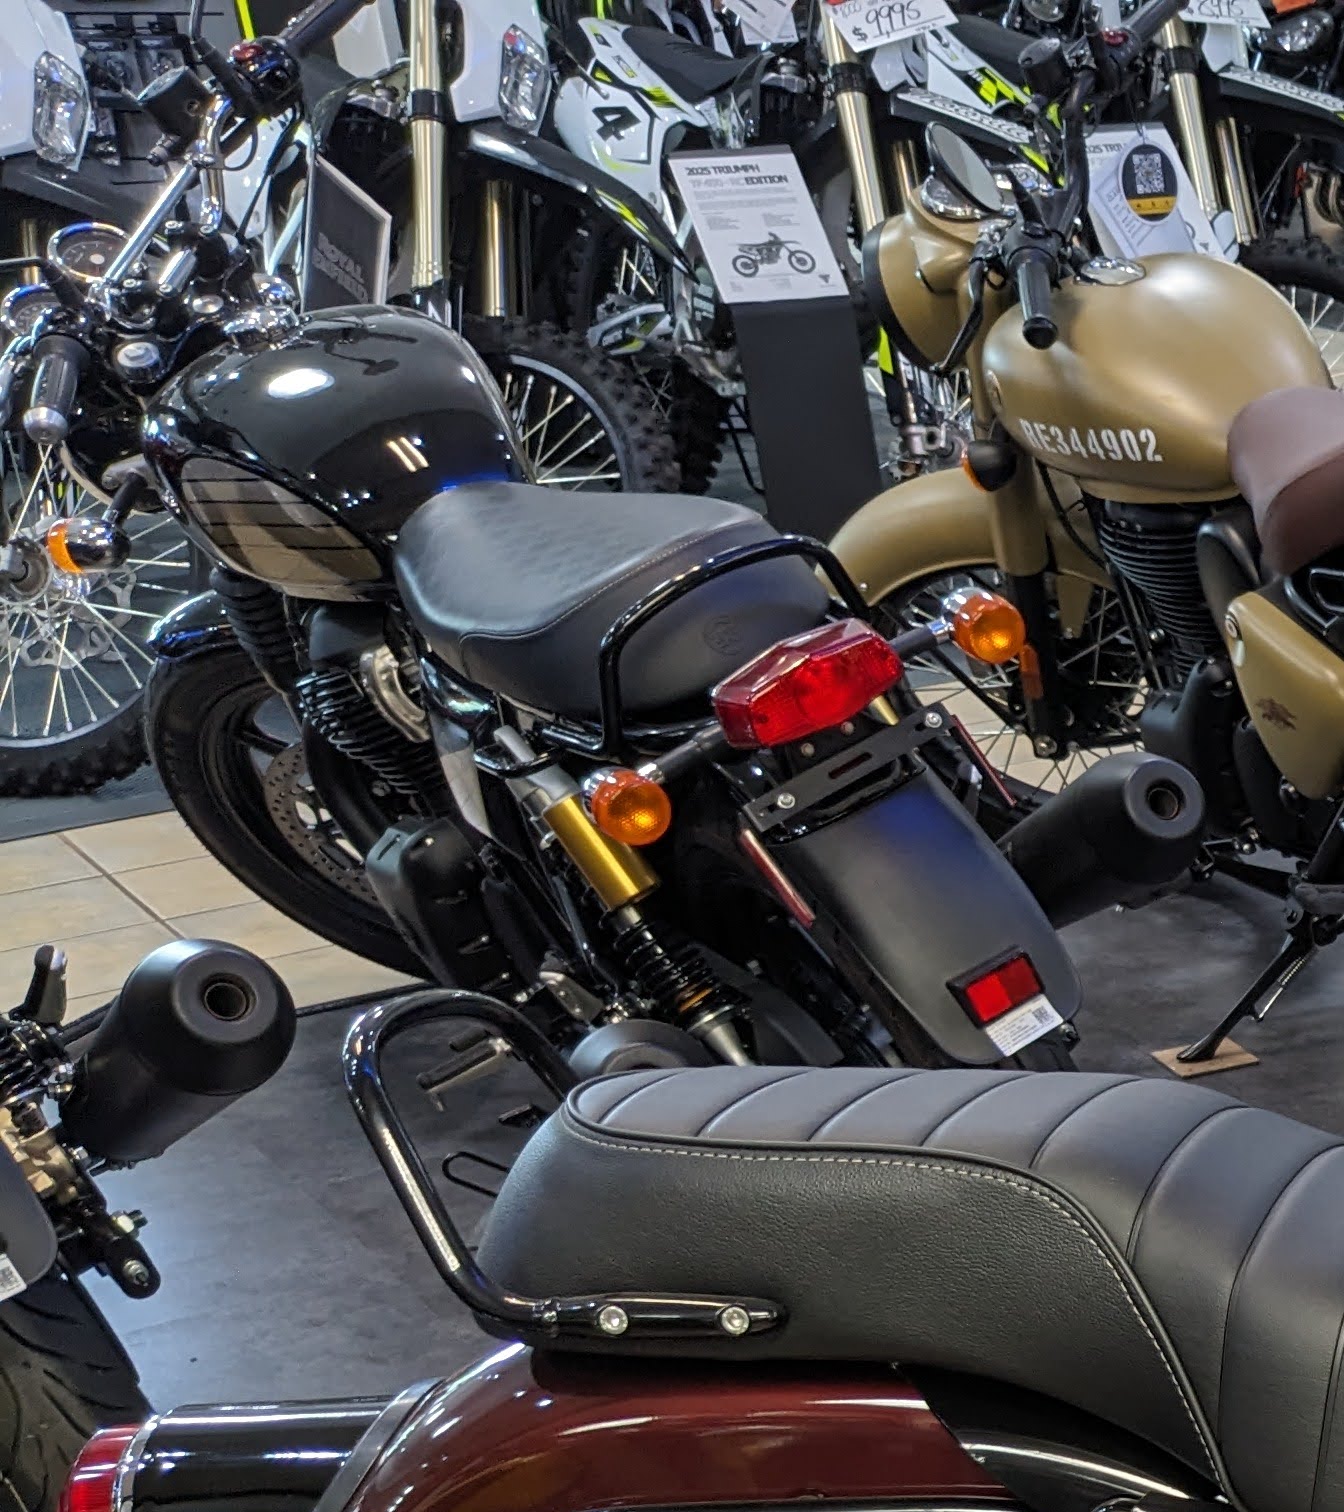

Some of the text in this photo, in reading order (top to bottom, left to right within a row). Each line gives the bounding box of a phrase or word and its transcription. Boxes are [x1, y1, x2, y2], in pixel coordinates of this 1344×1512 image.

[591, 106, 642, 141] 4
[685, 164, 760, 176] 2025 TRIUMPH
[744, 175, 789, 185] EDITION
[1019, 418, 1163, 462] RE344902
